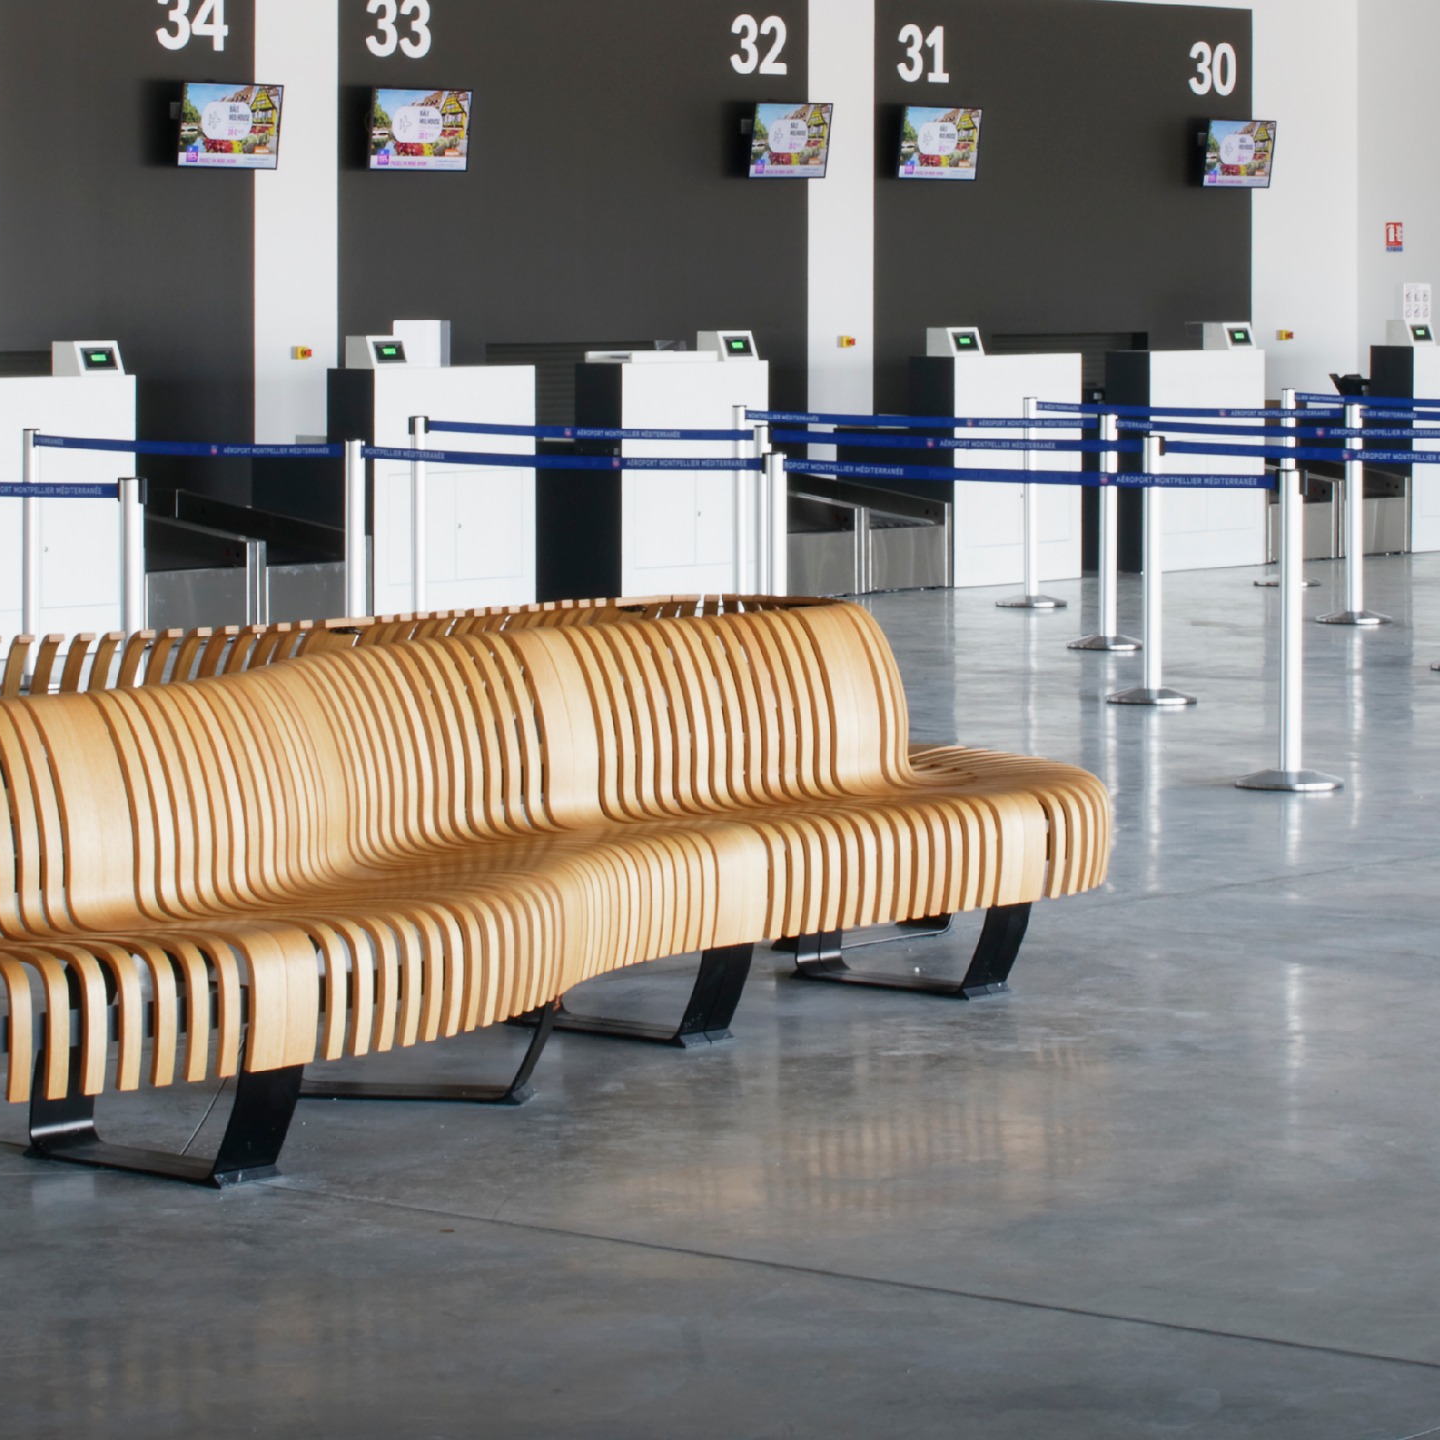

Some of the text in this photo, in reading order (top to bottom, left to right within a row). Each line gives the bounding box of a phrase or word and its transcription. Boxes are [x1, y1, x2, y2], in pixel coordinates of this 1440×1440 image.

[730, 14, 787, 75] 32
[897, 24, 949, 83] 31
[1188, 41, 1236, 96] 30
[1044, 419, 1083, 427] MÉDITERRANÉE
[641, 430, 680, 438] MÉDITERRANÉE
[940, 439, 1056, 449] AÉROPORT MONTPELLIER MÉDITERRANÉE
[404, 450, 445, 460] MÉDITERRANÉE
[1393, 453, 1436, 461] MONTPELLIER
[626, 458, 657, 466] AÉROPORT
[659, 459, 700, 467] MONTPELLIER
[811, 463, 853, 473] MONTPELLIER
[855, 464, 904, 476] MÉDITERRANÉE
[1117, 475, 1257, 486] AÉROPORT MONTPELLIER MÉDITERRANÉE
[56, 486, 102, 495] MÉDITERRANÉE
